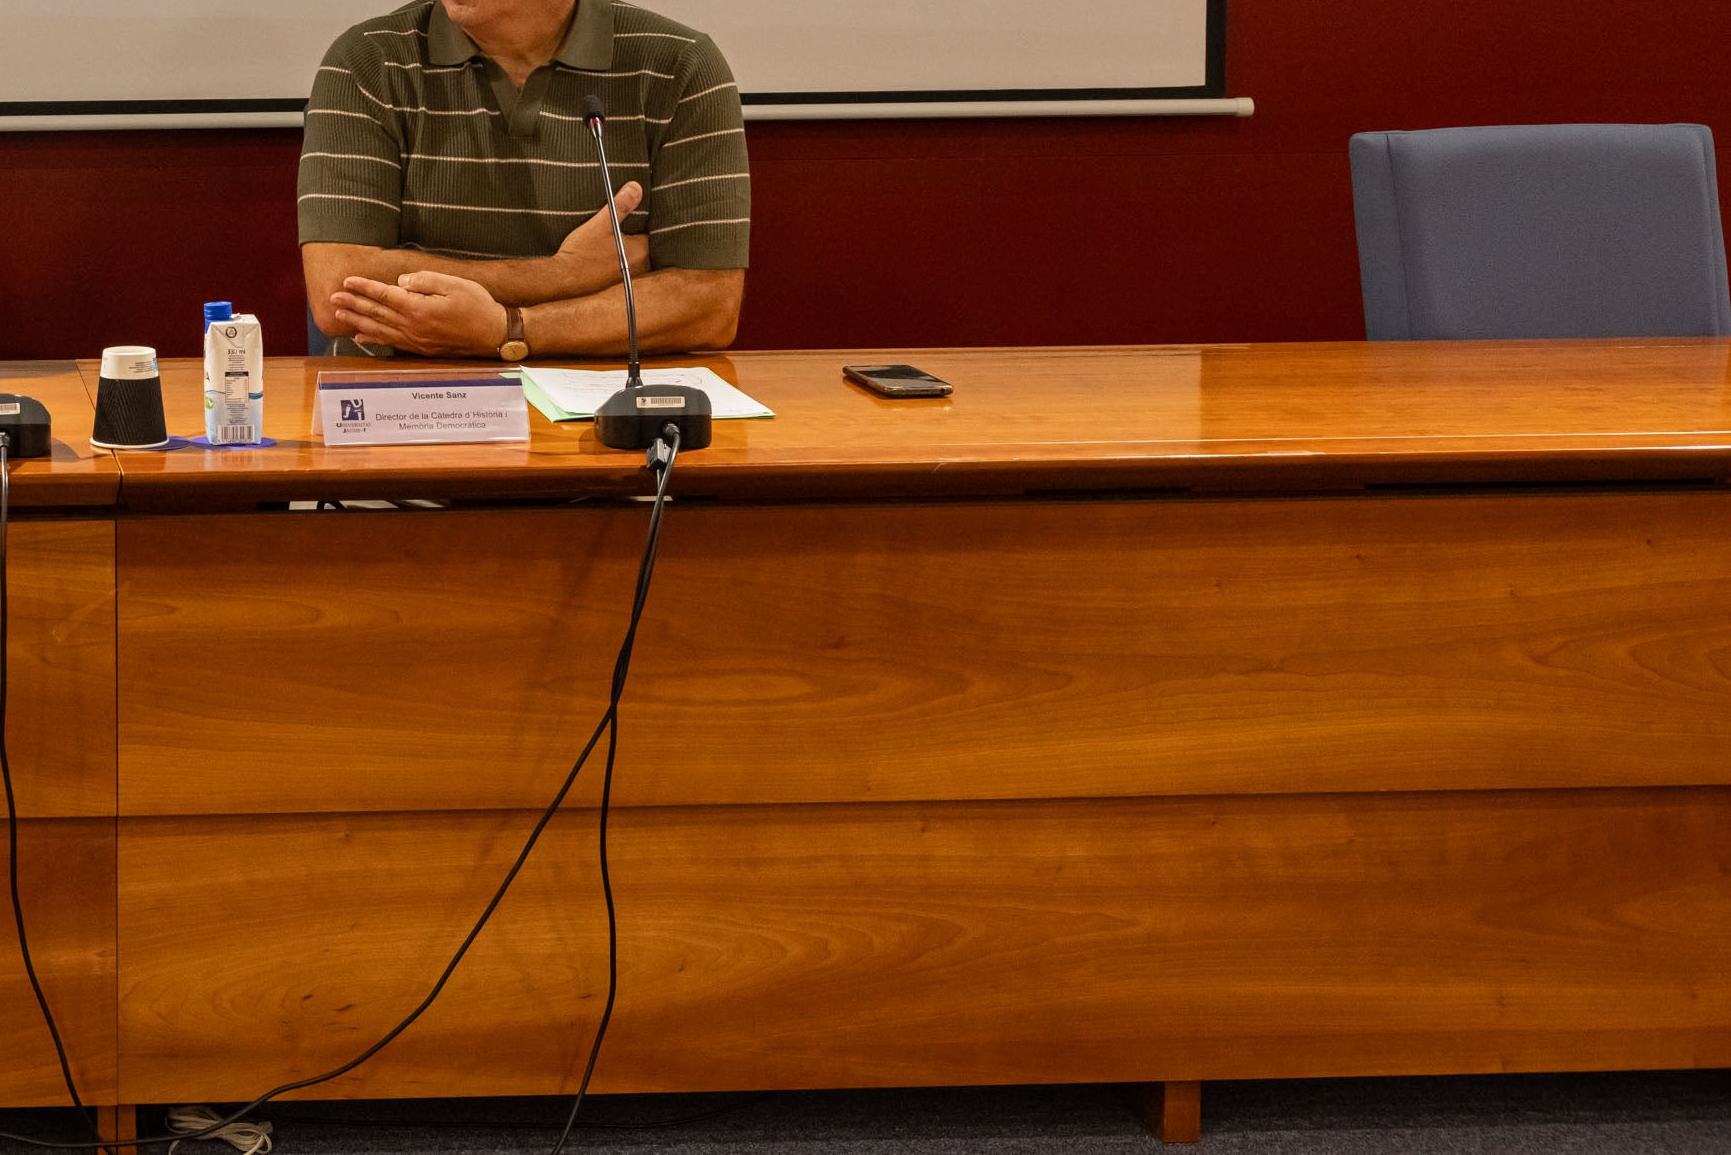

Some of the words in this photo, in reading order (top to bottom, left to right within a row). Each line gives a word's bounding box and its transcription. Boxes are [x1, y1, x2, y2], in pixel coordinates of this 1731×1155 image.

[411, 392, 444, 400] Vicente
[446, 391, 468, 399] Sanz
[375, 413, 407, 421] Director
[421, 412, 429, 420] la
